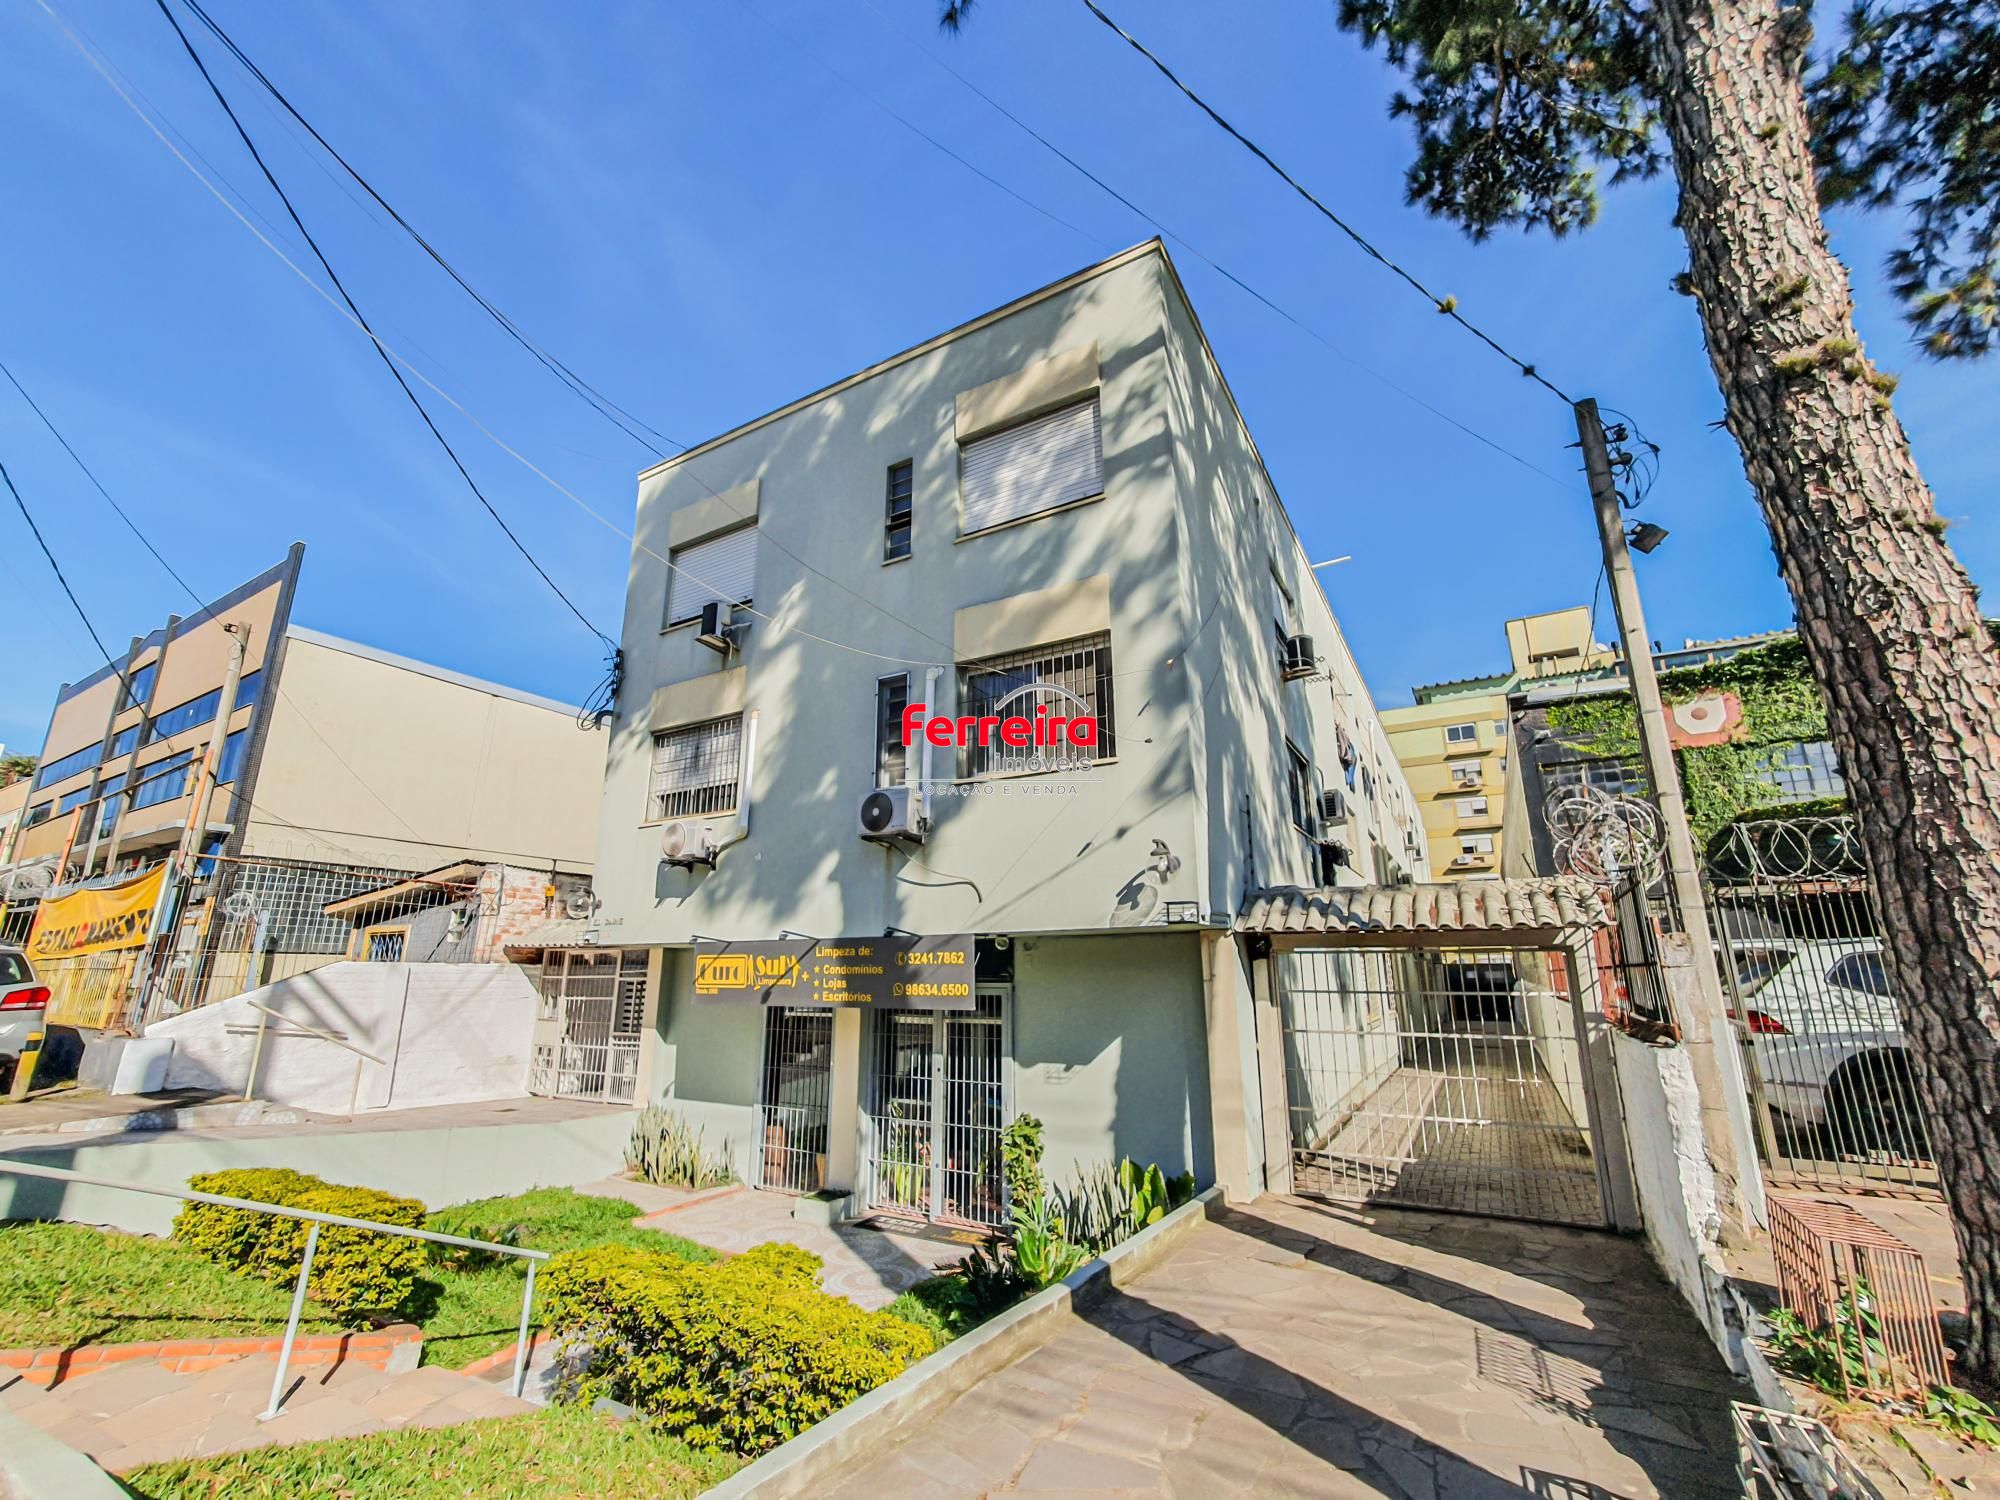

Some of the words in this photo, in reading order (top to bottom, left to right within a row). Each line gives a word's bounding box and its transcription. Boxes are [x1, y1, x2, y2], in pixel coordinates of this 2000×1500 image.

[815, 946, 856, 959] Limpeza
[858, 945, 874, 956] de:
[908, 951, 965, 965] 3241.7862
[755, 954, 786, 976] Sul
[822, 977, 847, 990] Lojas
[905, 983, 969, 996] 98634.6500
